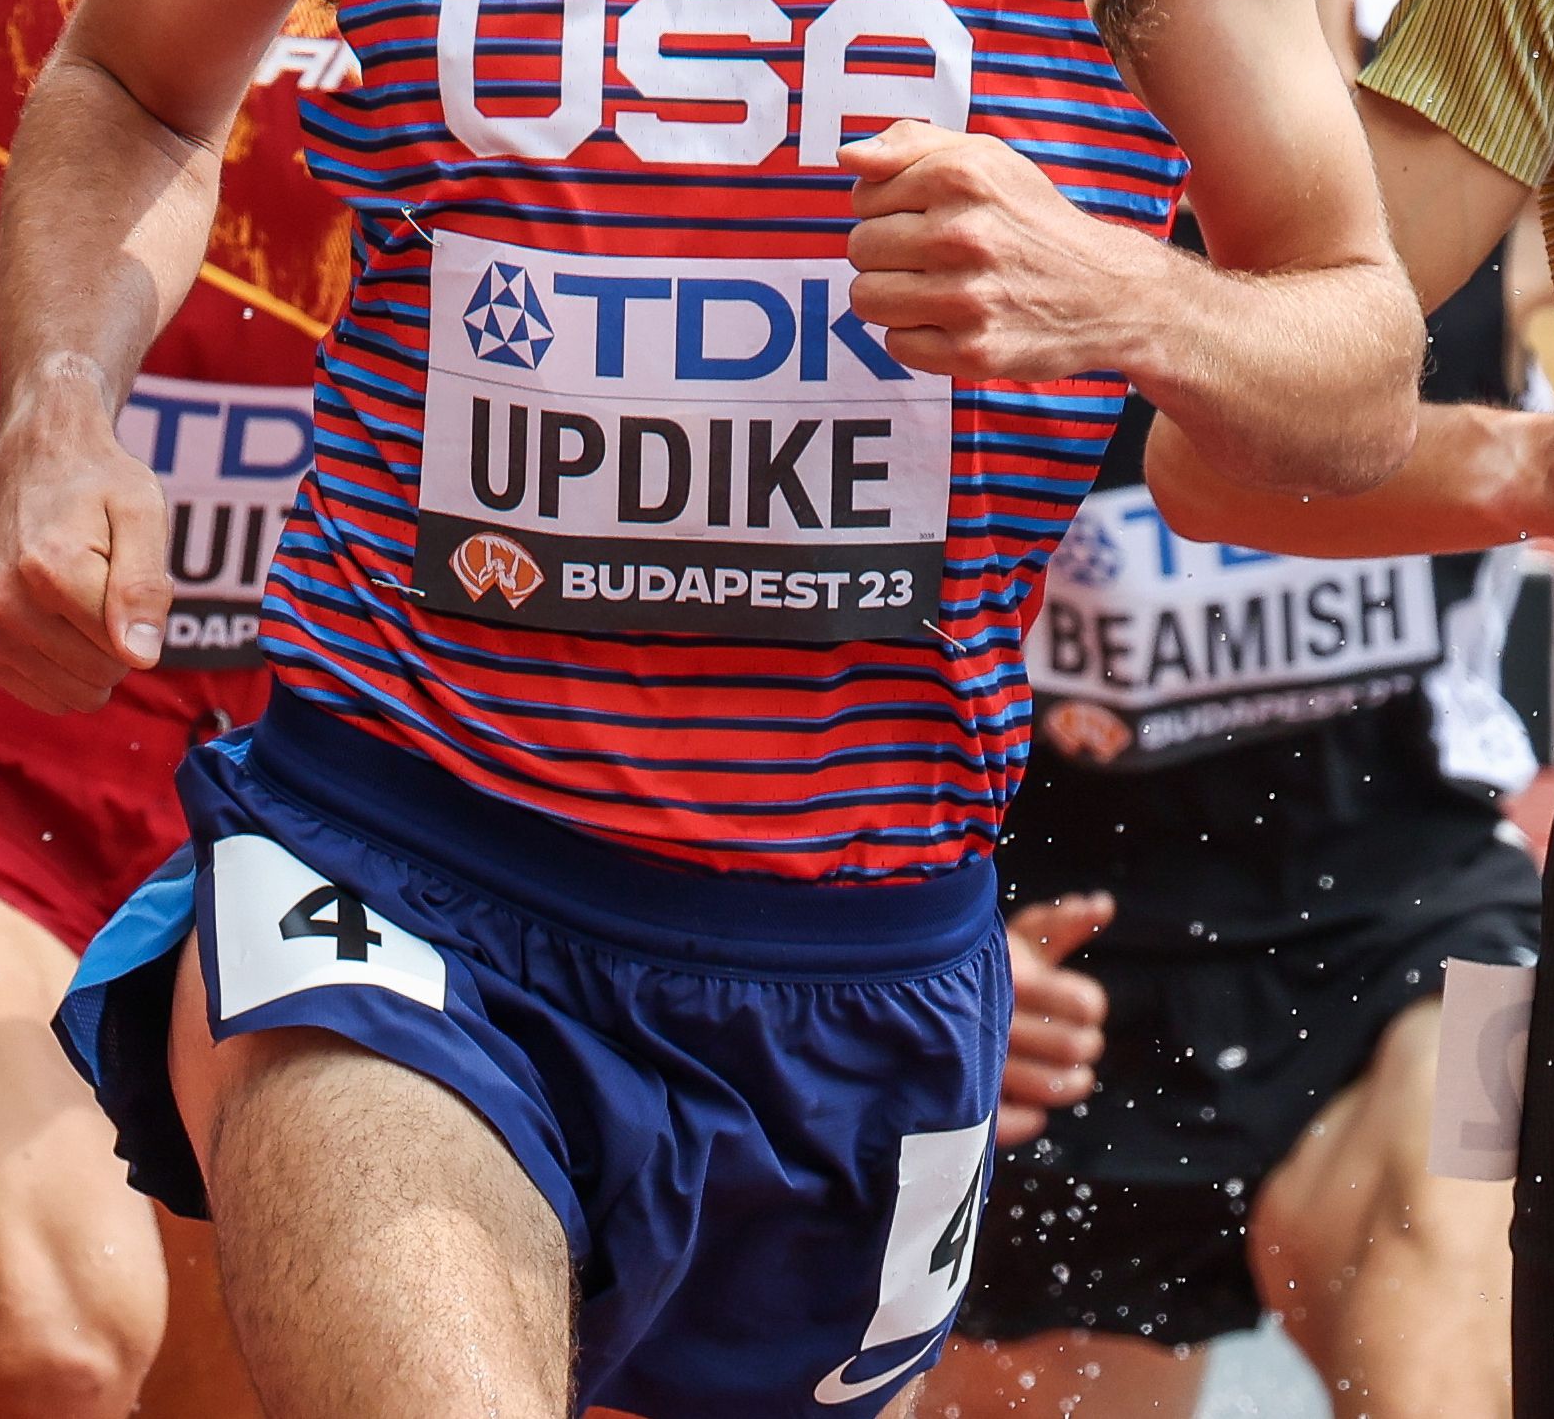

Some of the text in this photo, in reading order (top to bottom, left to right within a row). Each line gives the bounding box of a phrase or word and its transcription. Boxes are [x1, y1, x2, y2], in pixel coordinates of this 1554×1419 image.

[469, 396, 893, 530] UPDIKE
[561, 563, 915, 611] BUDAPEST 23
[1048, 567, 1404, 689] BEAMISH
[279, 882, 383, 963] 4
[928, 1145, 987, 1293] 4
